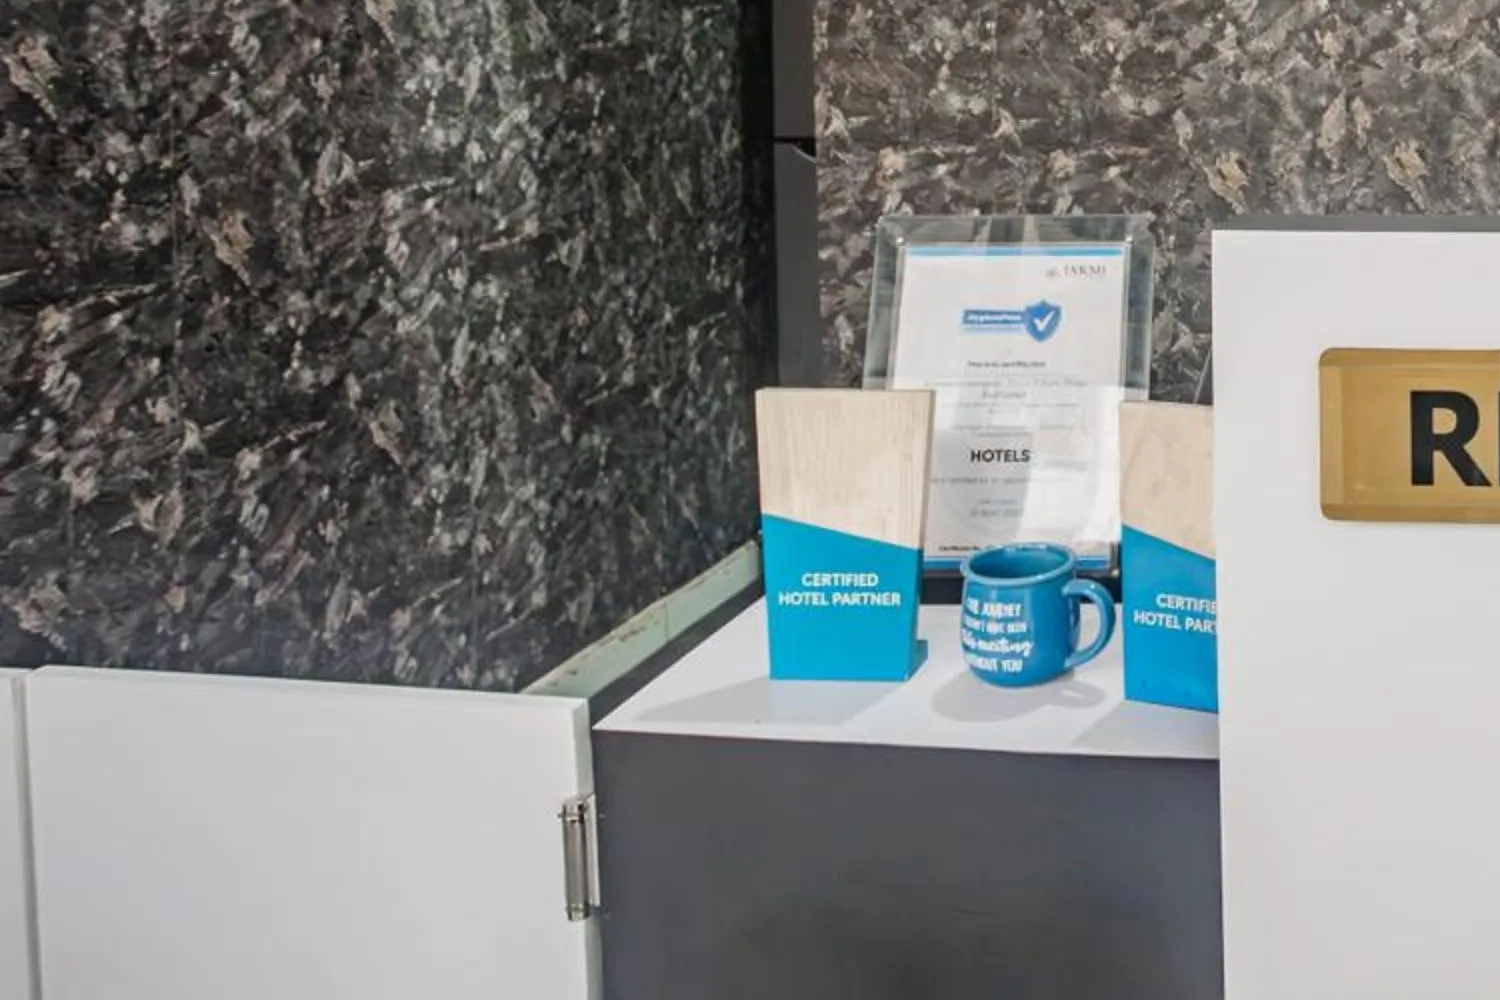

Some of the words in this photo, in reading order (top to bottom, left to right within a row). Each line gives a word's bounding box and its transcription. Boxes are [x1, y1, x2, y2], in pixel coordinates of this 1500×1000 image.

[970, 449, 1031, 463] HOTELS
[801, 572, 879, 587] CERTIFIED
[778, 591, 829, 606] HOTEL
[832, 591, 902, 607] PARTNER
[1133, 609, 1182, 630] HOTEL
